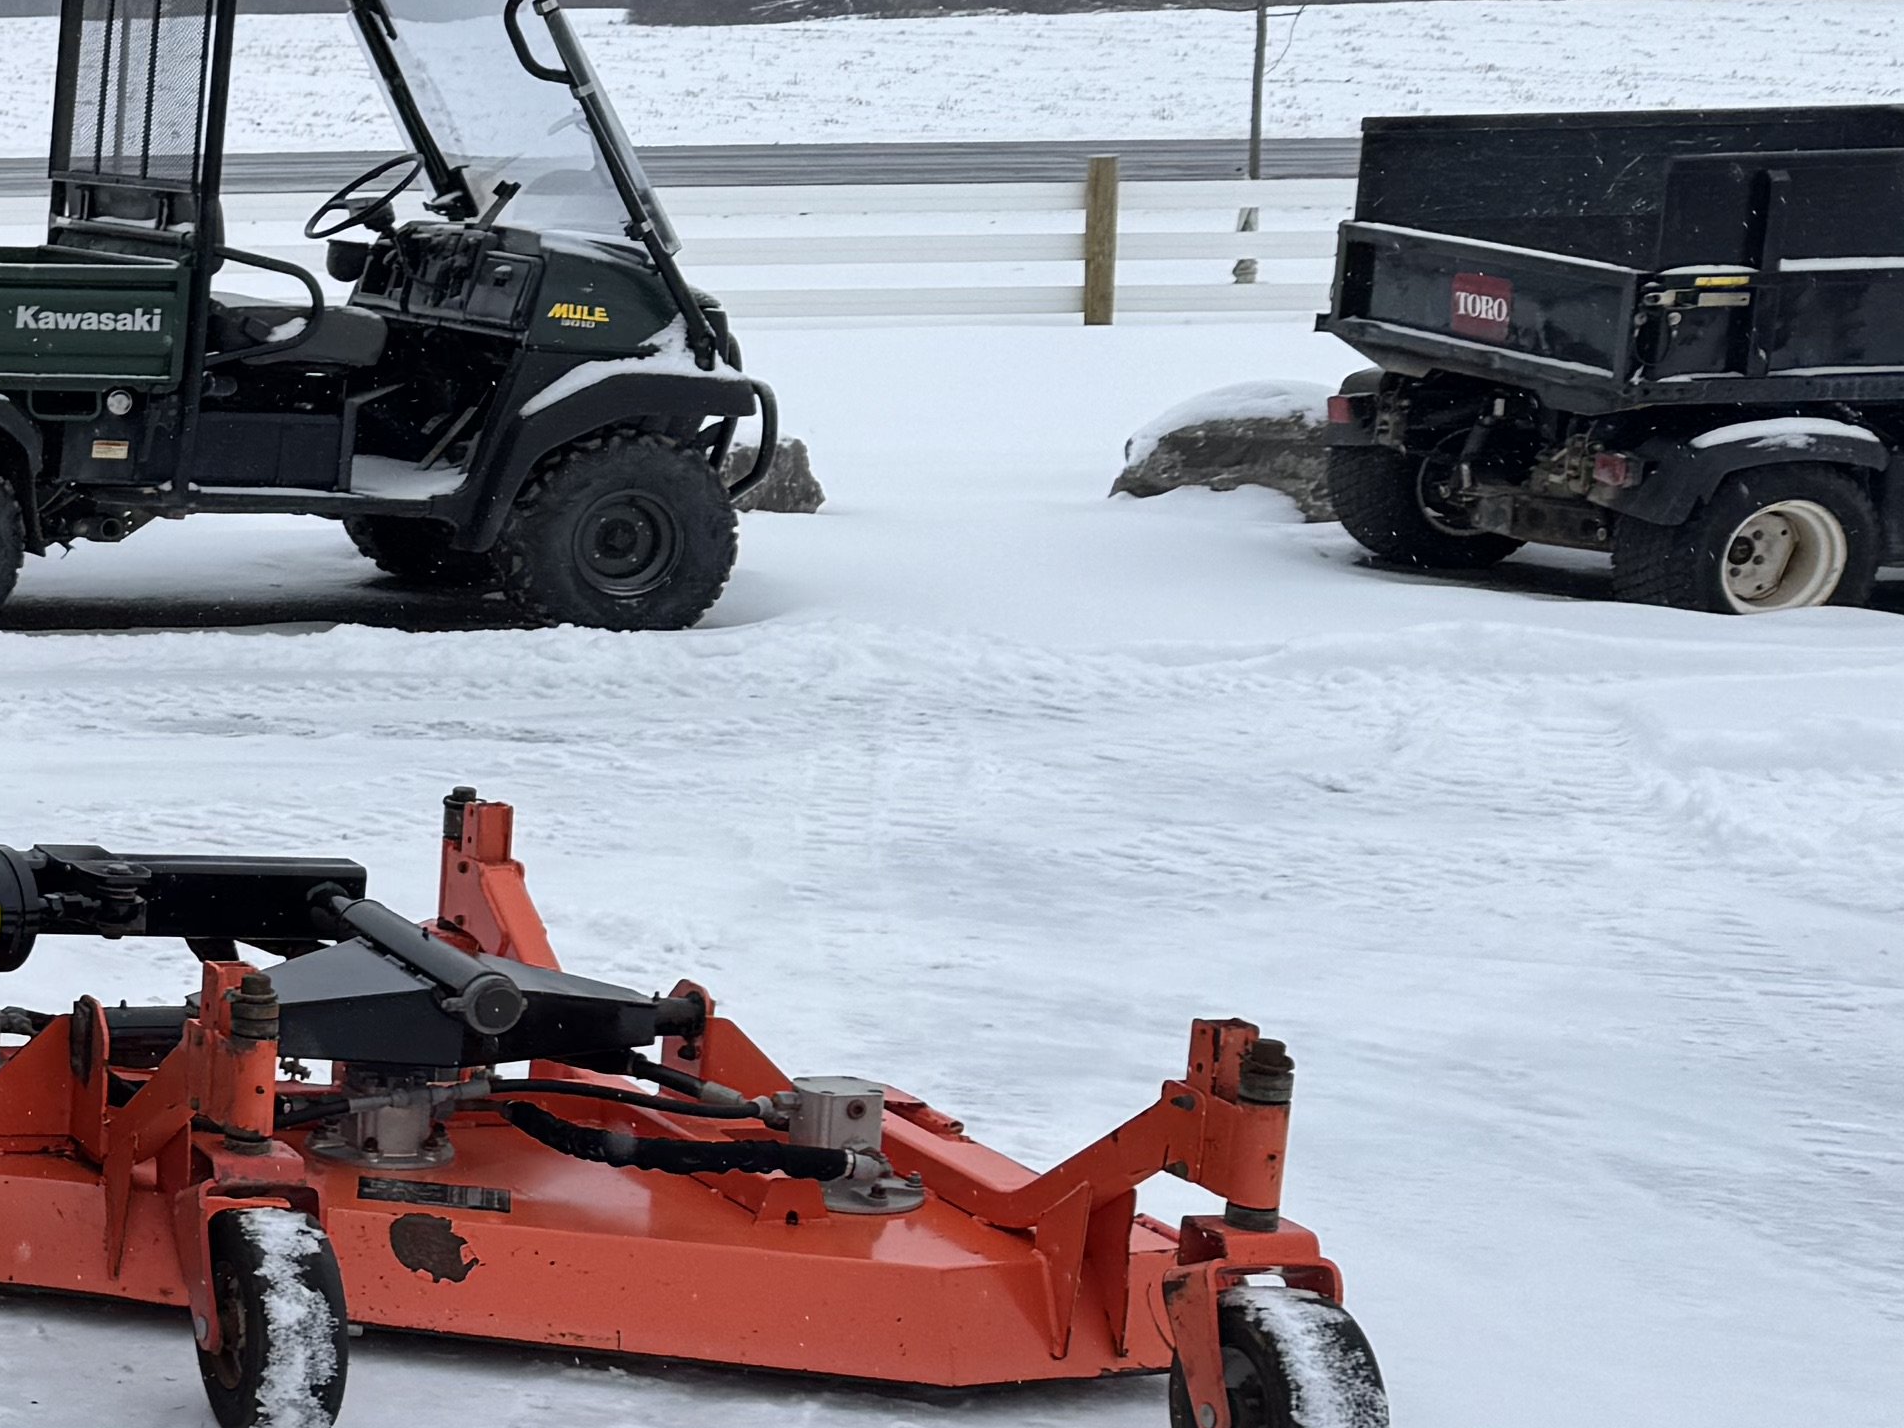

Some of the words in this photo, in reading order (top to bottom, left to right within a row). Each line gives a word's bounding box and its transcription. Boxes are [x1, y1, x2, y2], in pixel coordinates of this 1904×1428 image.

[15, 305, 162, 332] Kawasaki
[547, 303, 610, 322] MULE
[1455, 291, 1508, 322] TORO
